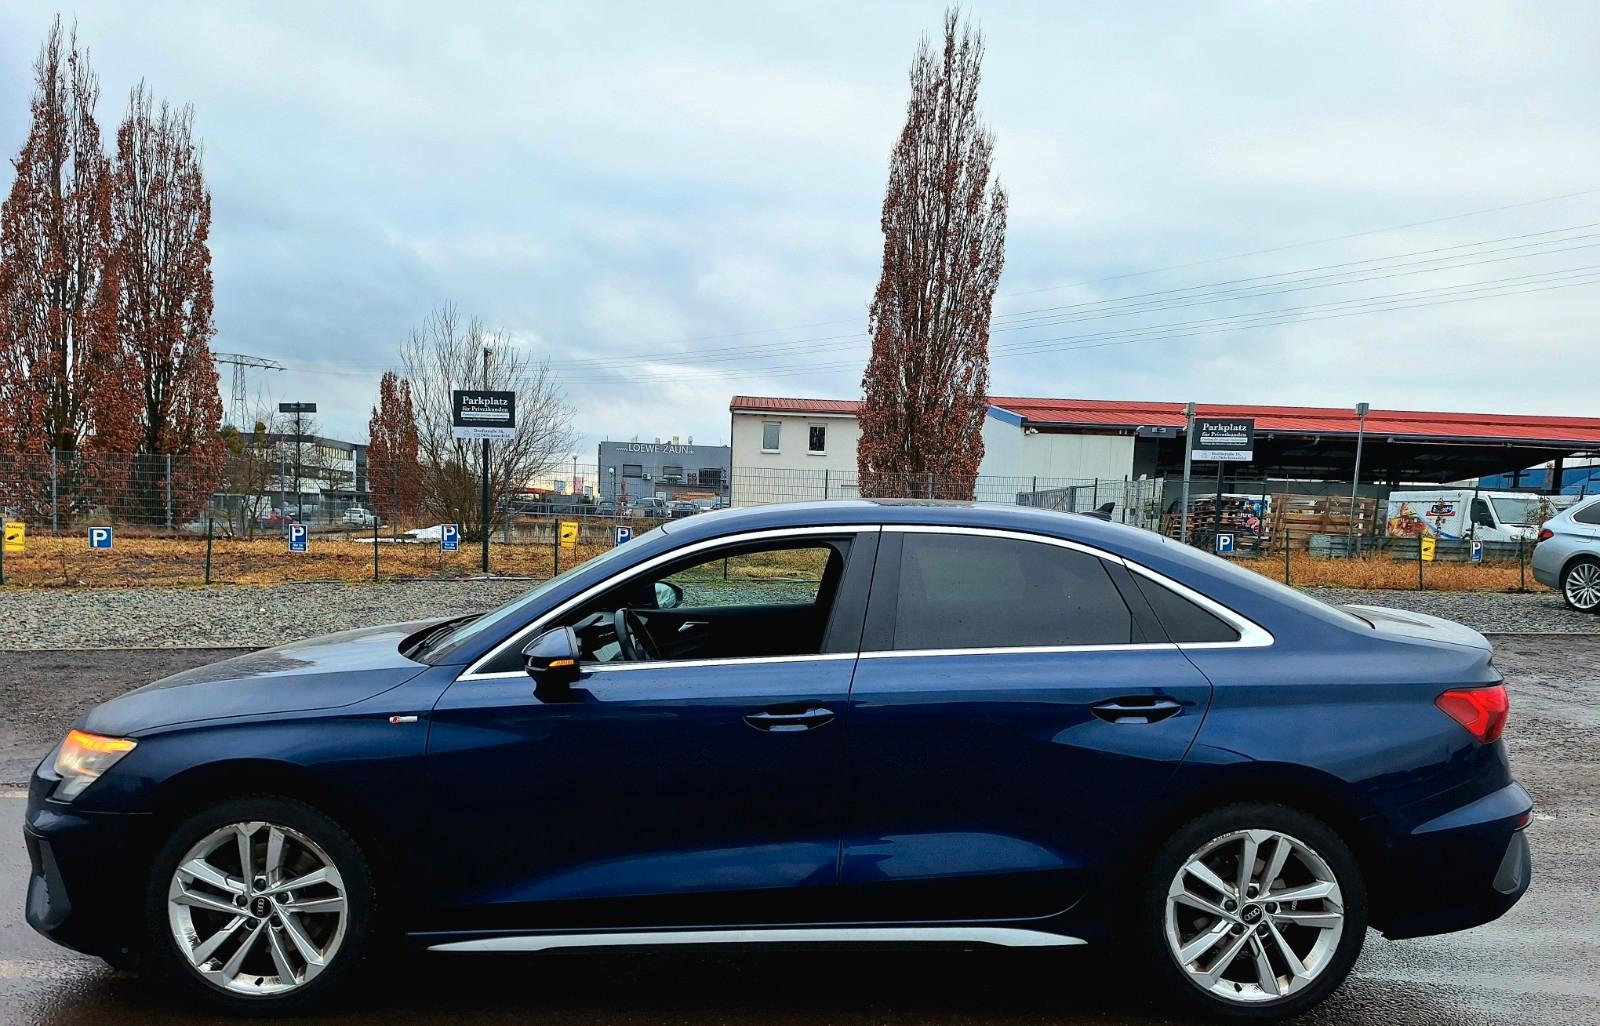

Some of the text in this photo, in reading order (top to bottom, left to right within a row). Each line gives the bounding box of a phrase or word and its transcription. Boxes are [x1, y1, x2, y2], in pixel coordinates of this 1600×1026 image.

[462, 395, 509, 407] Parkplatz
[1202, 422, 1247, 433] Parkplatz
[93, 529, 108, 547] P
[292, 526, 305, 542] P
[443, 526, 456, 541] P
[617, 527, 629, 543] P
[1219, 535, 1231, 551] P
[1472, 541, 1481, 555] P
